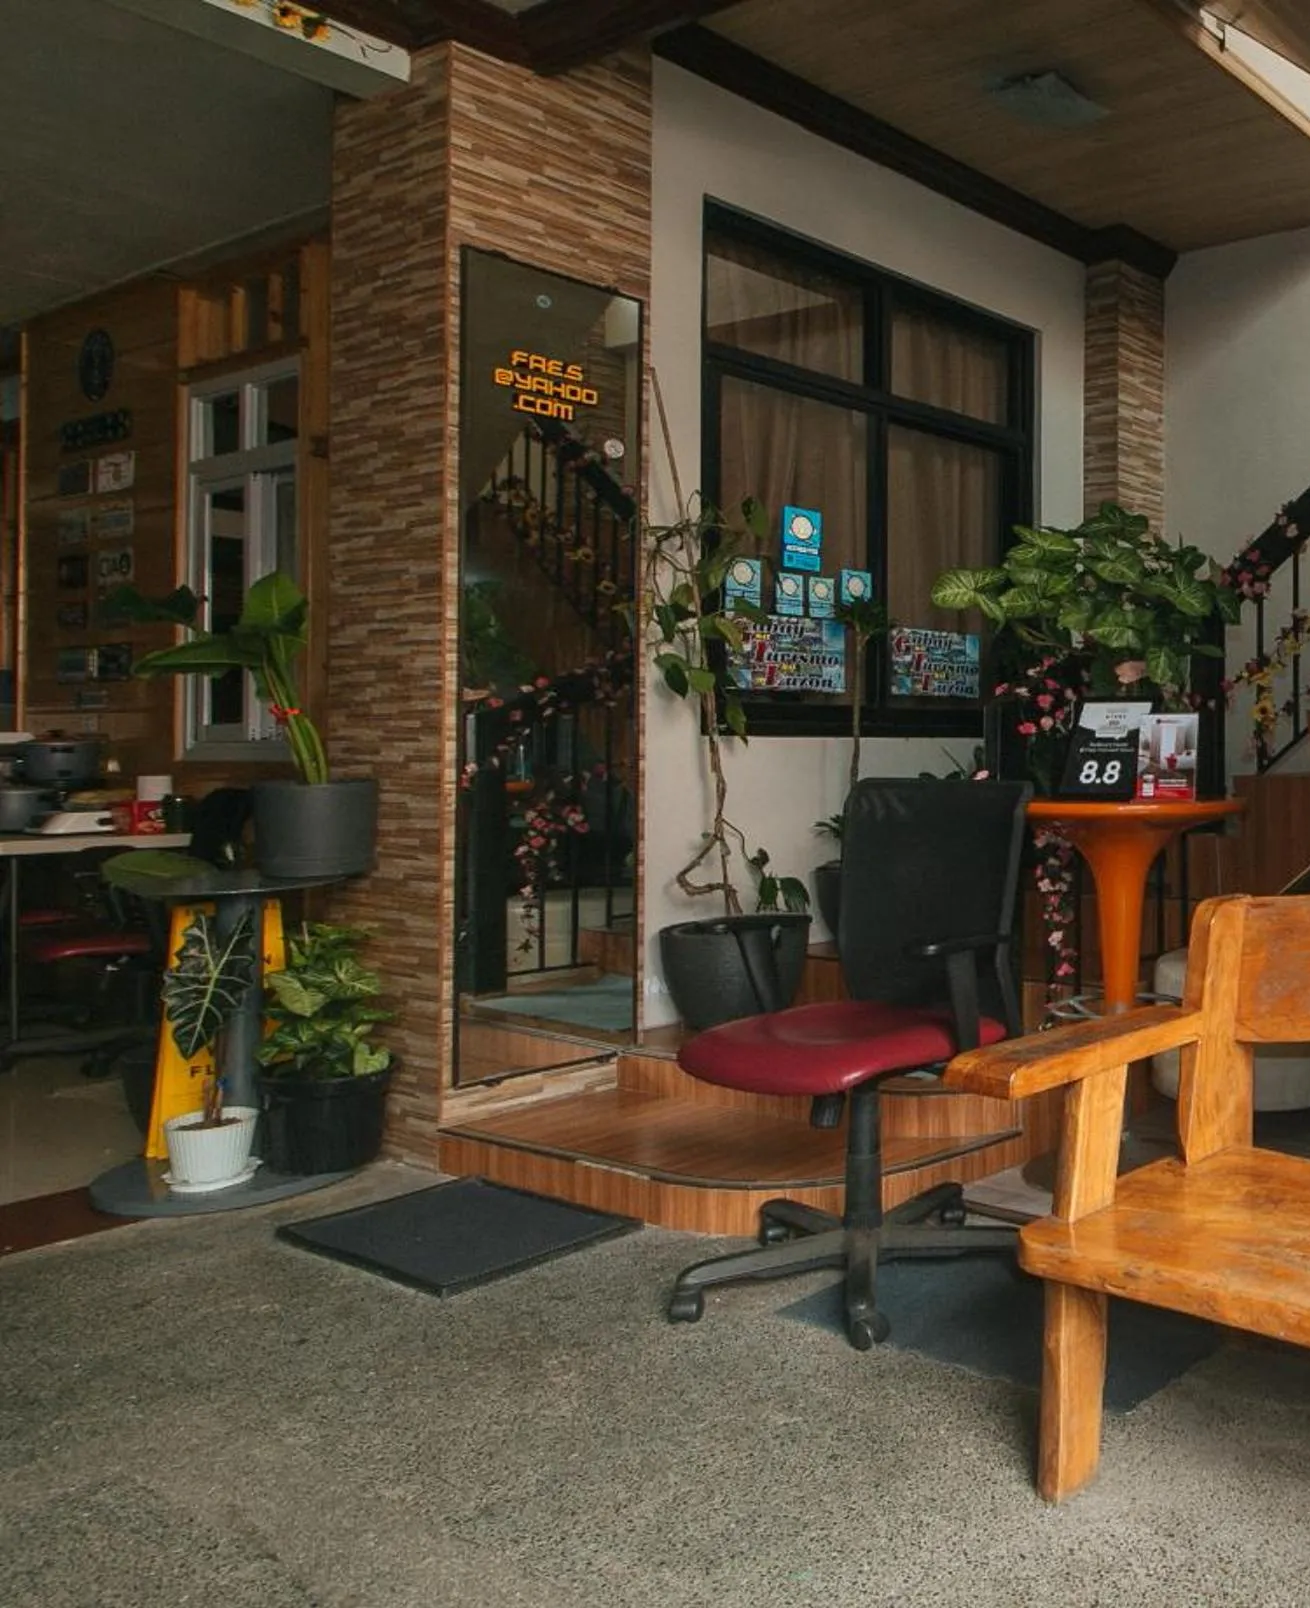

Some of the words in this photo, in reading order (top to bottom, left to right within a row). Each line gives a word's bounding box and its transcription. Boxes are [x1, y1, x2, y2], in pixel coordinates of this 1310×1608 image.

[511, 350, 584, 382] FAES
[495, 368, 598, 405] @YAHOO
[513, 395, 574, 421] .COM
[1079, 760, 1122, 785] 8.8
